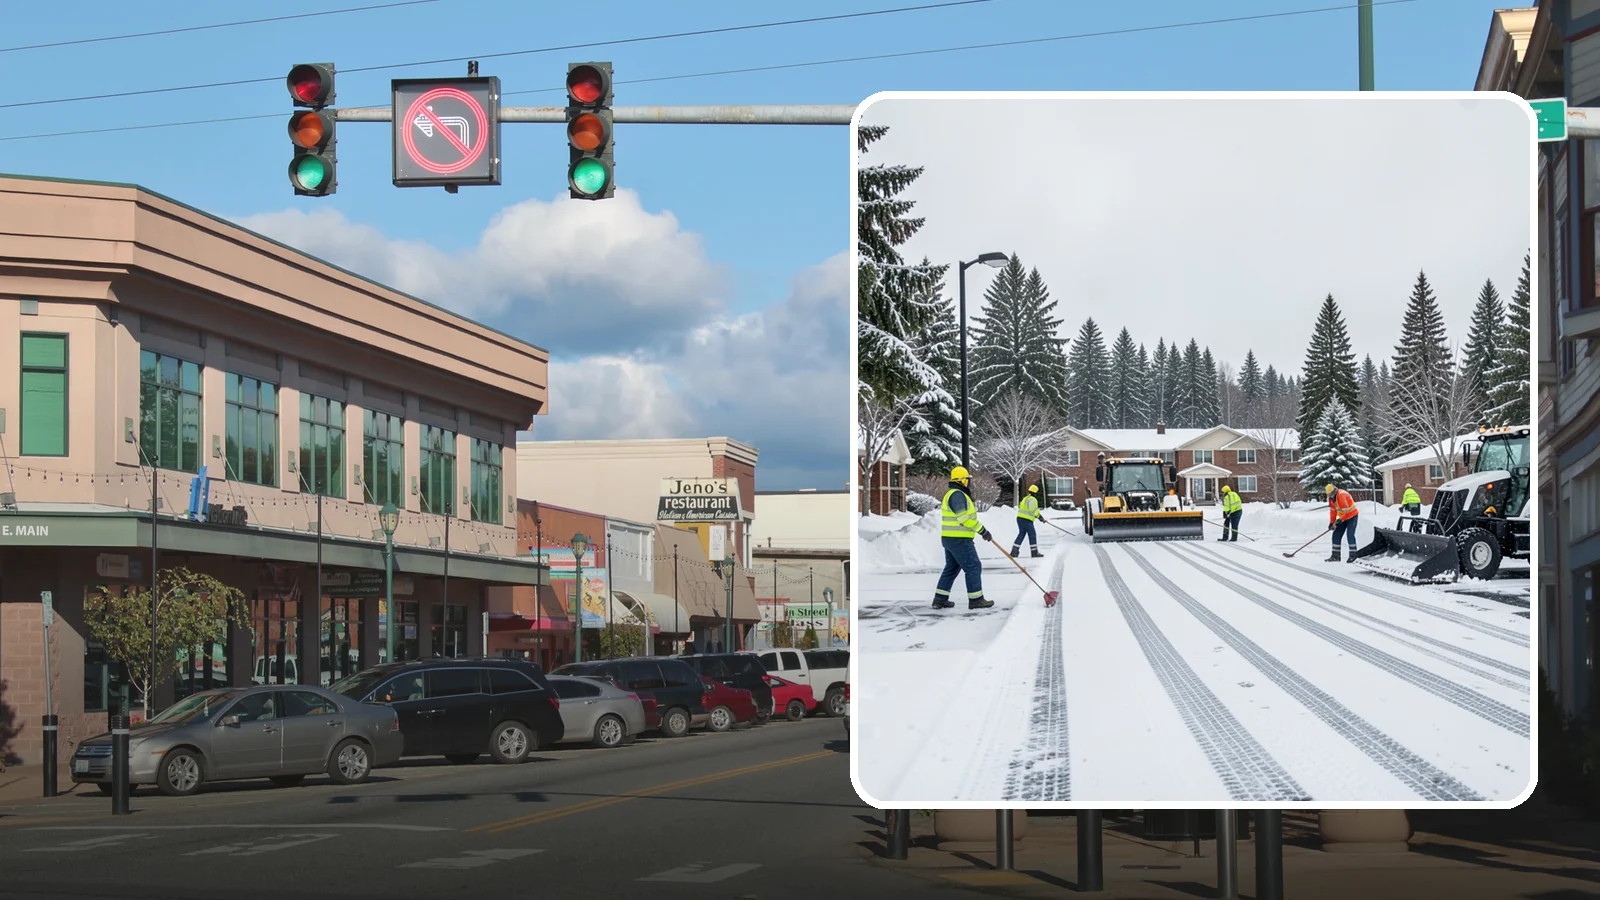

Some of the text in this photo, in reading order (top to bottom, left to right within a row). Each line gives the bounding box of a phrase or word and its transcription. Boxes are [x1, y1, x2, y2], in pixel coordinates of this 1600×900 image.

[669, 480, 728, 494] Jeno's
[665, 497, 731, 509] restaurant
[658, 510, 682, 519] Italian
[686, 509, 715, 519] American
[715, 509, 738, 519] Cuisine
[2, 525, 49, 536] E. MAIN
[797, 607, 829, 617] Street
[788, 619, 824, 627] lass
